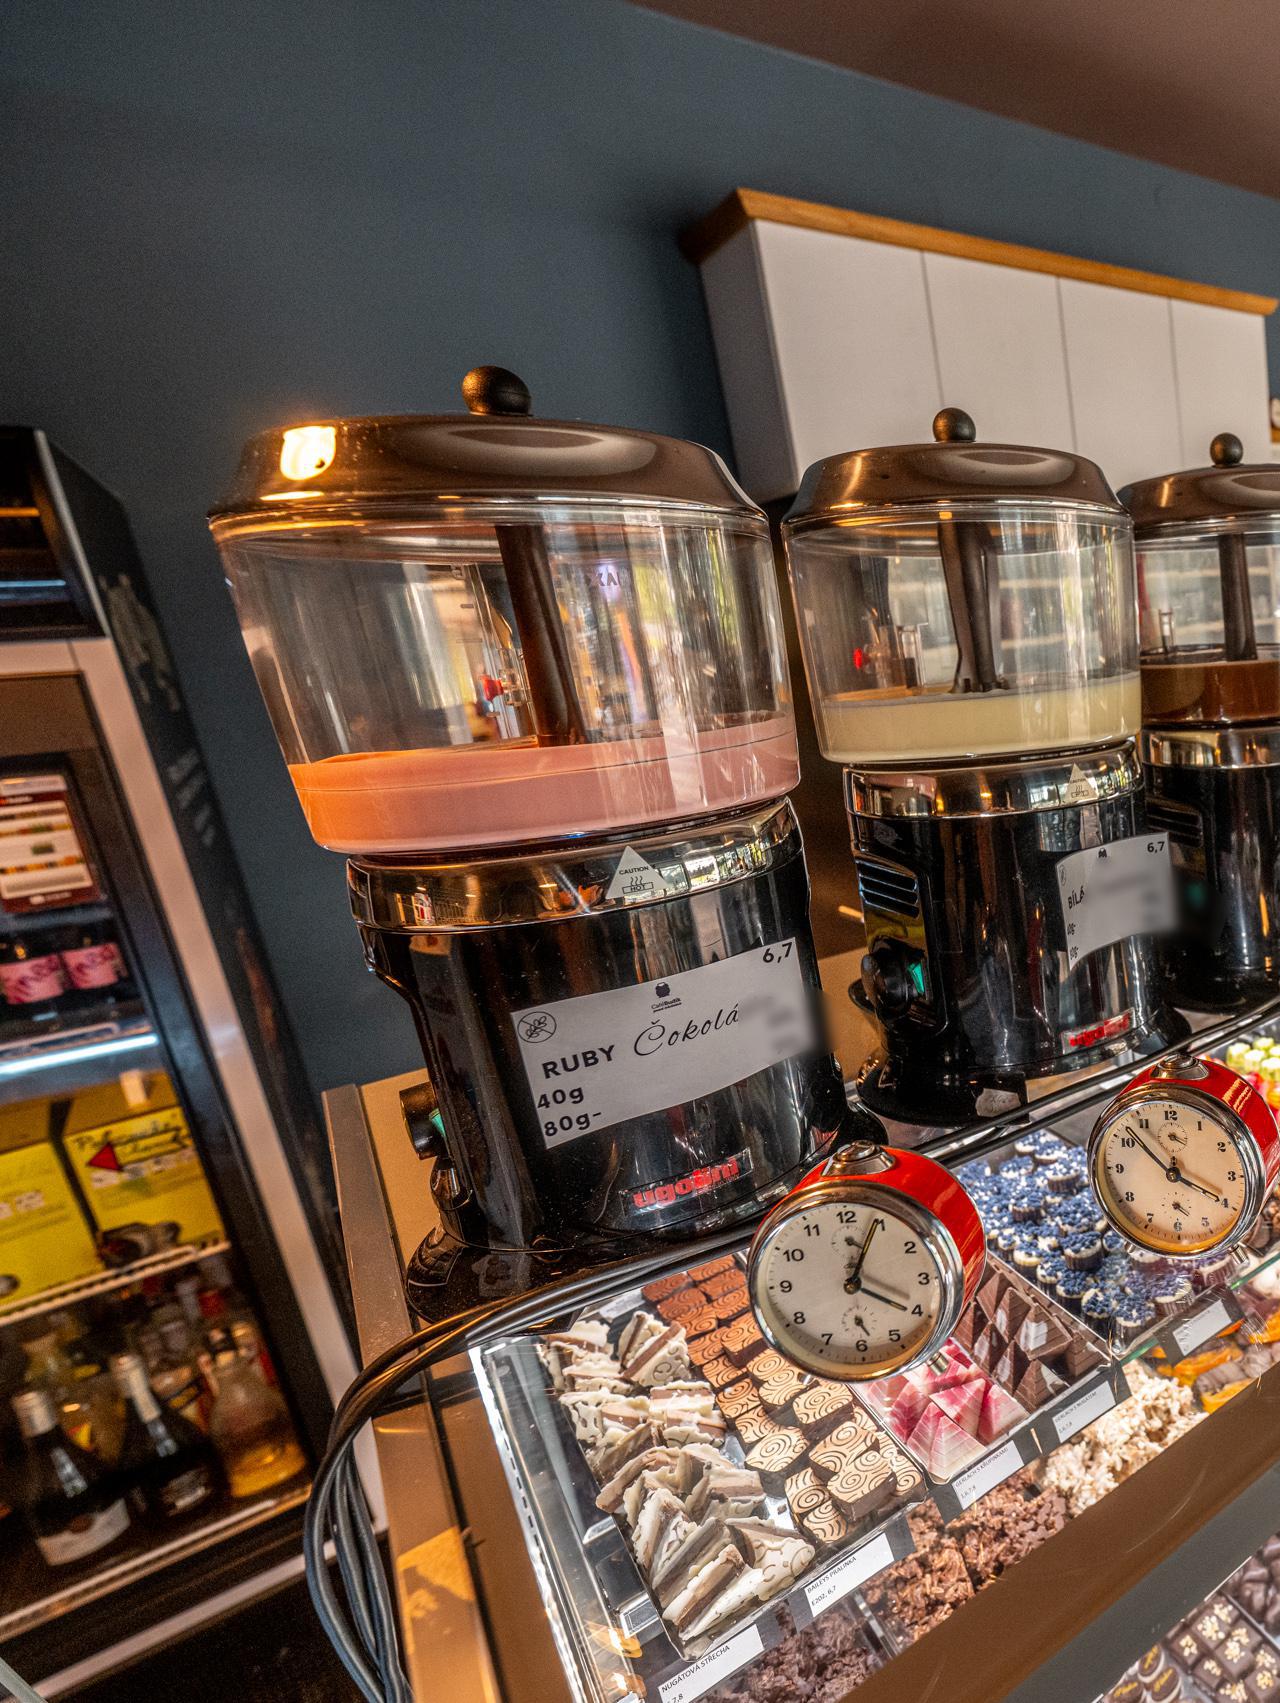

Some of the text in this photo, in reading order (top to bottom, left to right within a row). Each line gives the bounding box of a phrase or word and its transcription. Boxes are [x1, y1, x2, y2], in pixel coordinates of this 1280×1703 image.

[1147, 841, 1165, 854] 6,7
[619, 865, 649, 875] CAUTION
[630, 884, 645, 892] HOT
[762, 941, 793, 964] 6,7
[542, 1044, 615, 1079] RUBY
[634, 998, 773, 1056] Čokolá
[537, 1087, 584, 1109] 40g
[1163, 1110, 1178, 1121] 12
[544, 1112, 601, 1137] 80g-
[1139, 1119, 1149, 1129] 11
[1197, 1121, 1202, 1131] 1
[1121, 1138, 1136, 1148] 10
[1217, 1142, 1227, 1152] 2
[1115, 1163, 1125, 1174] 9
[1227, 1171, 1237, 1181] 3
[1125, 1192, 1135, 1202] 8
[1220, 1198, 1229, 1208] 4
[836, 1211, 857, 1223] 12
[1146, 1212, 1154, 1223] 7
[1201, 1217, 1210, 1227] 5
[803, 1224, 821, 1237] 11
[877, 1219, 886, 1231] 1
[1174, 1222, 1183, 1232] 6
[904, 1241, 917, 1254] 2
[783, 1249, 804, 1262] 10
[918, 1273, 930, 1285] 3
[780, 1280, 793, 1293] 9
[911, 1304, 924, 1317] 4
[793, 1312, 806, 1325] 8
[821, 1333, 833, 1346] 7
[888, 1329, 901, 1342] 5
[856, 1340, 868, 1352] 6
[807, 1556, 857, 1594] BAILEYS PRALINKA
[661, 1645, 731, 1693] NUGÁTOVÁ STŘECHA
